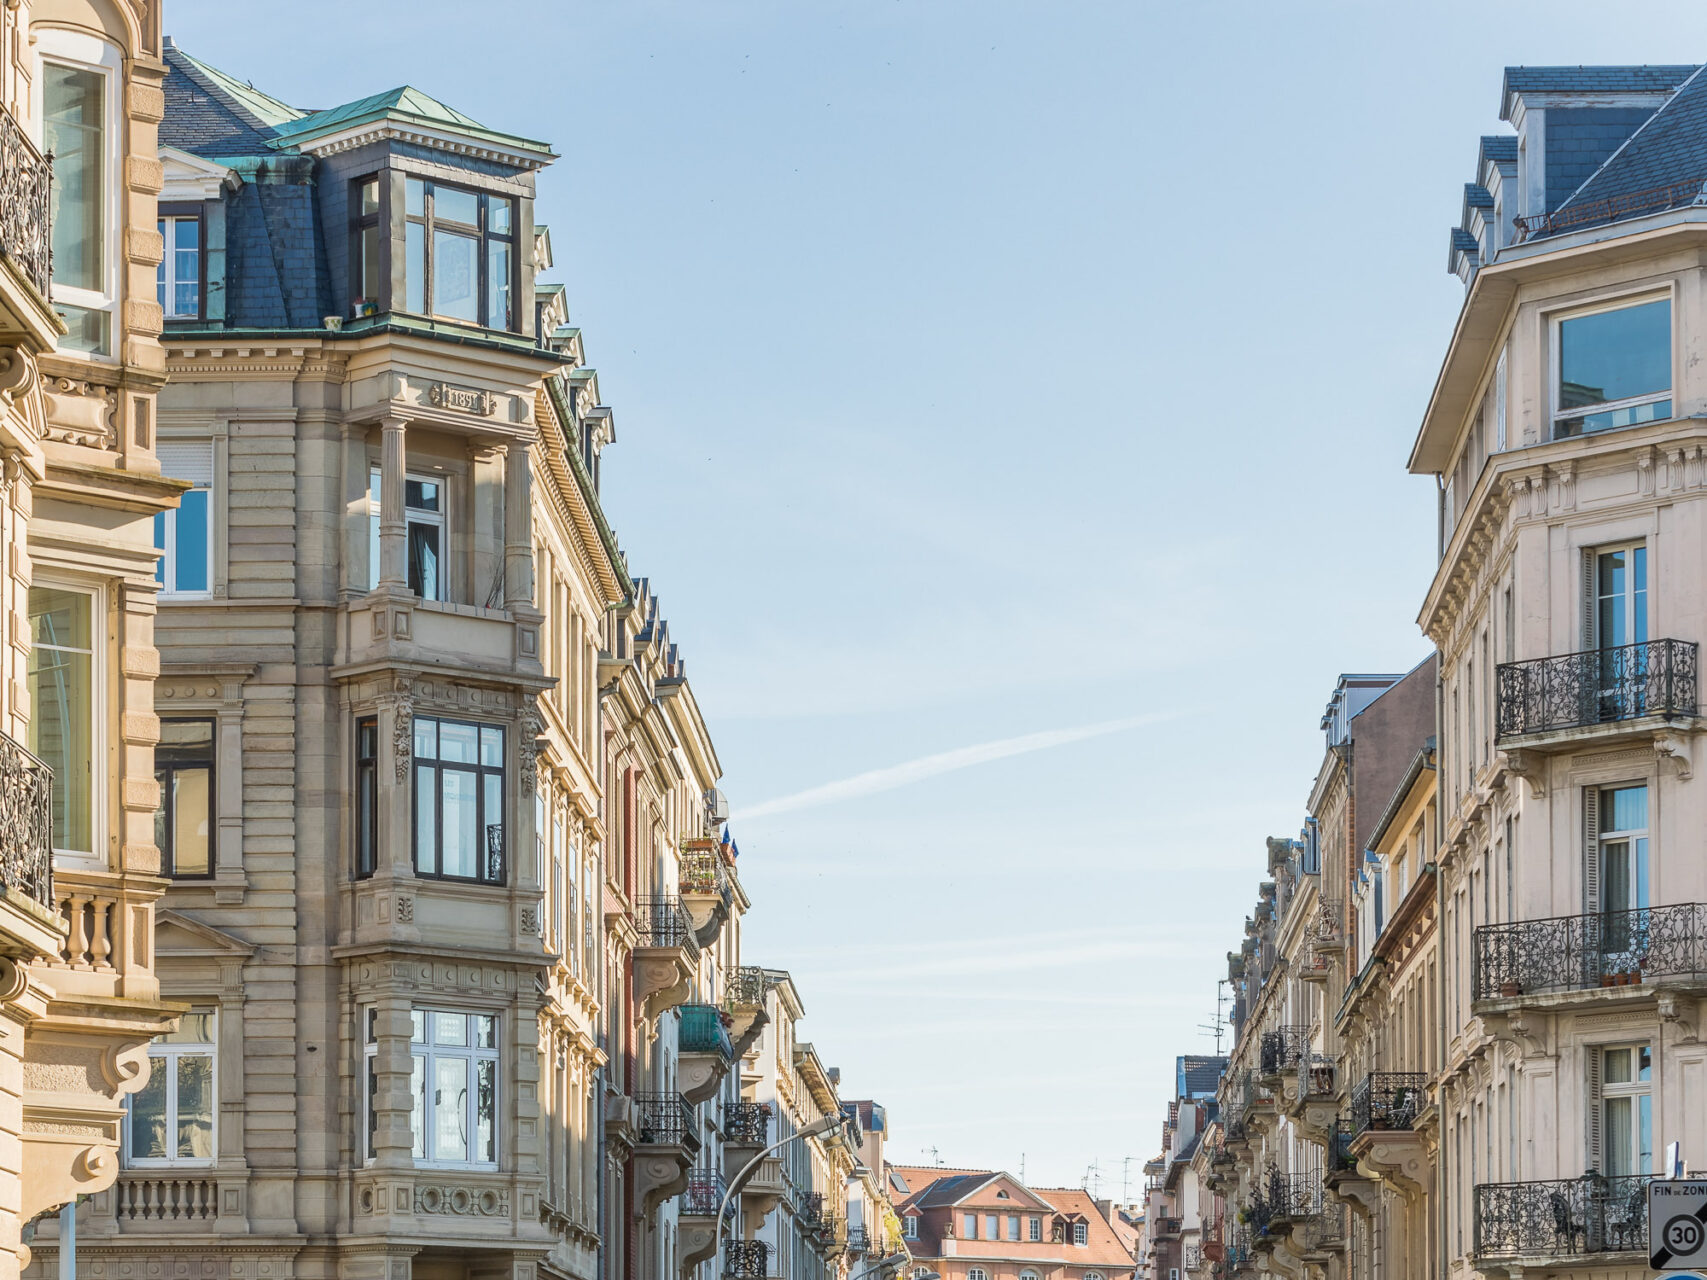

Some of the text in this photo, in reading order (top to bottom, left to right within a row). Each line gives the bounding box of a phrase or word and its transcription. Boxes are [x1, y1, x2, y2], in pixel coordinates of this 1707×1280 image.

[1654, 1186, 1672, 1196] FIN
[1682, 1185, 1707, 1196] ZON
[1671, 1226, 1697, 1244] 30
